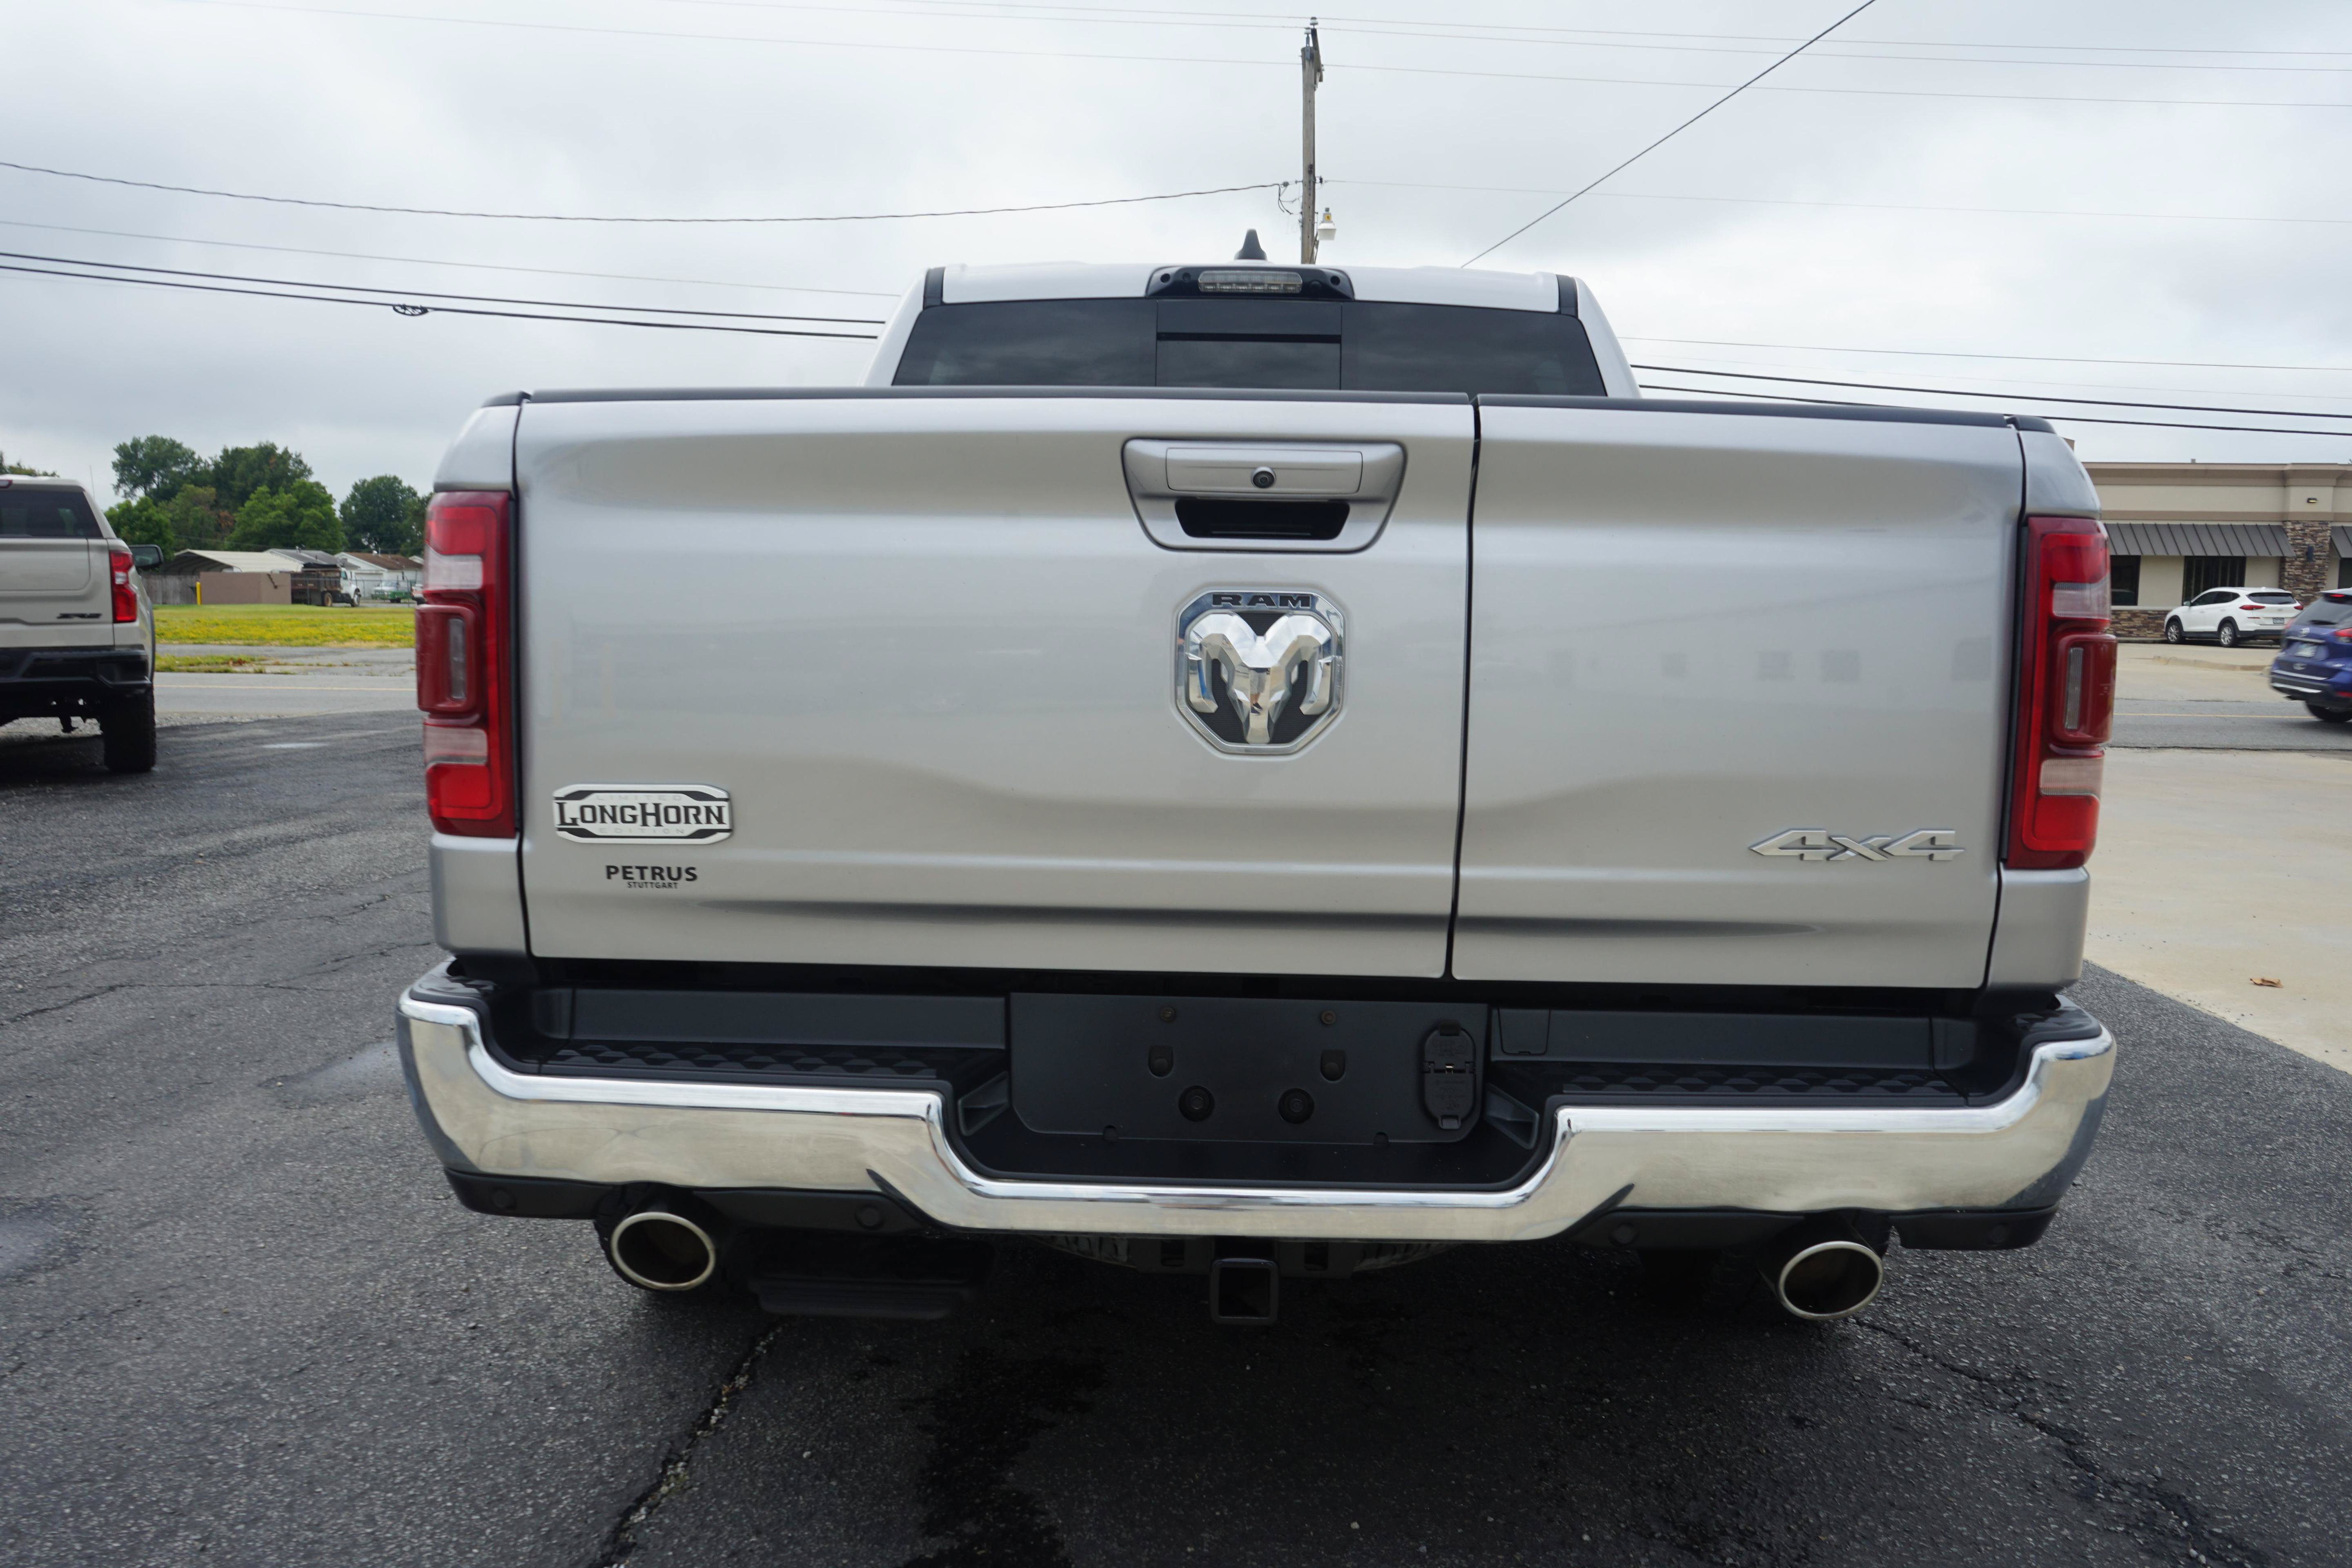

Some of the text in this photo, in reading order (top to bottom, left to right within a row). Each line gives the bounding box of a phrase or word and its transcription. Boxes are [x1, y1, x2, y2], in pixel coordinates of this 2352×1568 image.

[1212, 594, 1312, 608] RAM
[556, 802, 727, 827] LONGHORN
[606, 865, 698, 882] PETRUS
